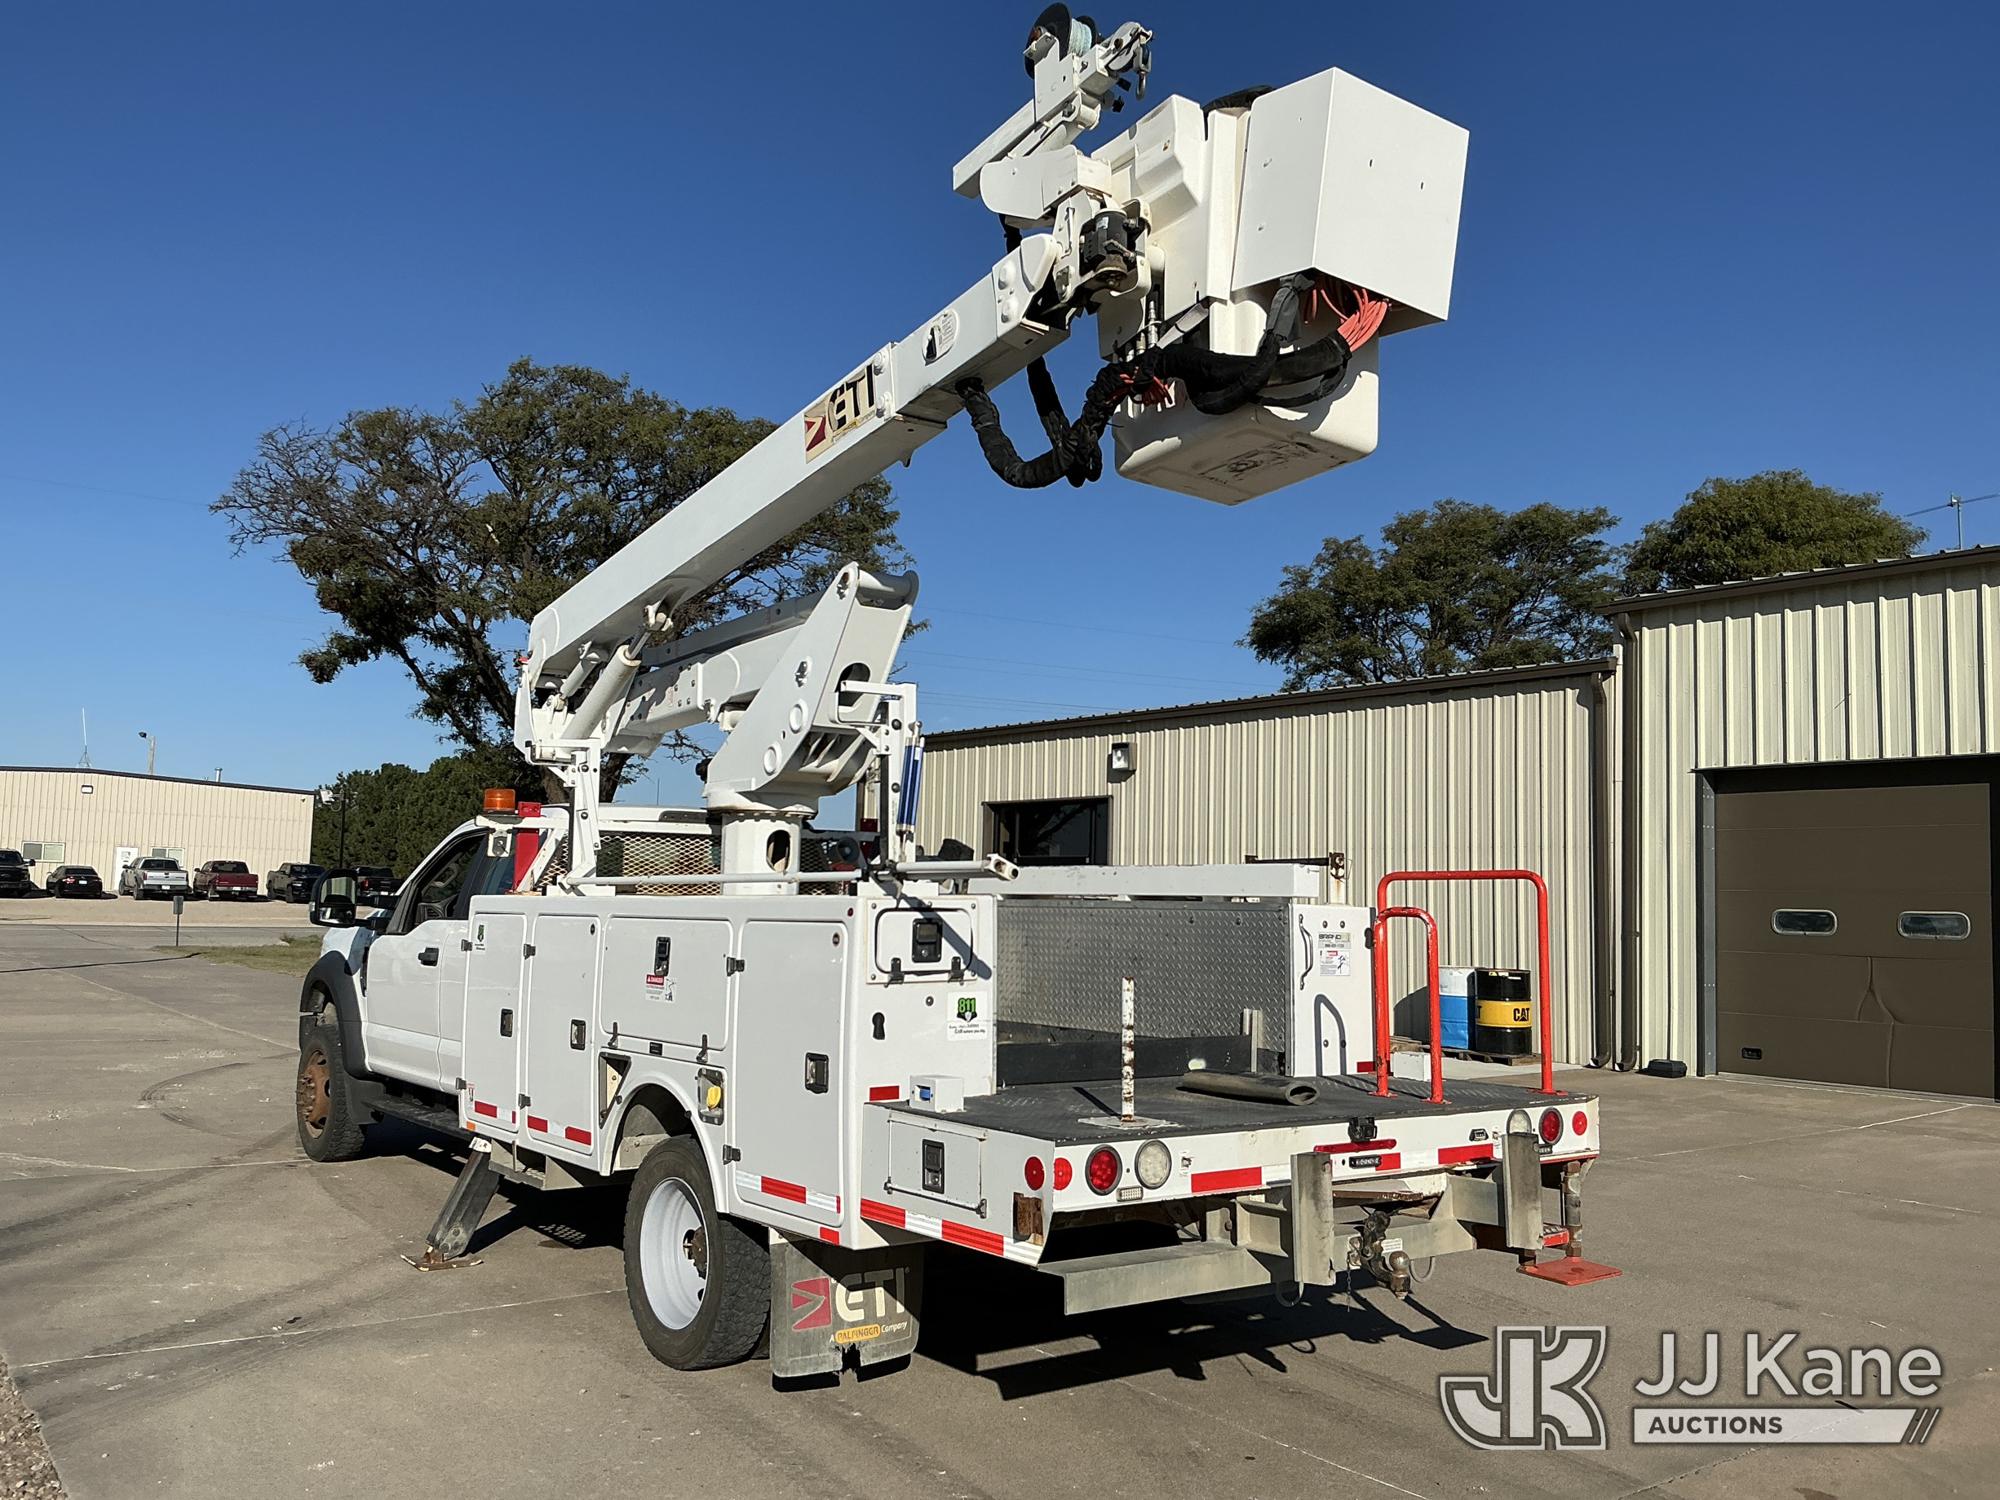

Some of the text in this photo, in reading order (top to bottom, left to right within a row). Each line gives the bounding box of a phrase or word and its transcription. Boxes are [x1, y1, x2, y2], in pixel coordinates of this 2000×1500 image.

[828, 363, 875, 432] ETI
[958, 998, 976, 1013] 811
[1513, 1007, 1530, 1022] CAT
[836, 1267, 905, 1322] ETI
